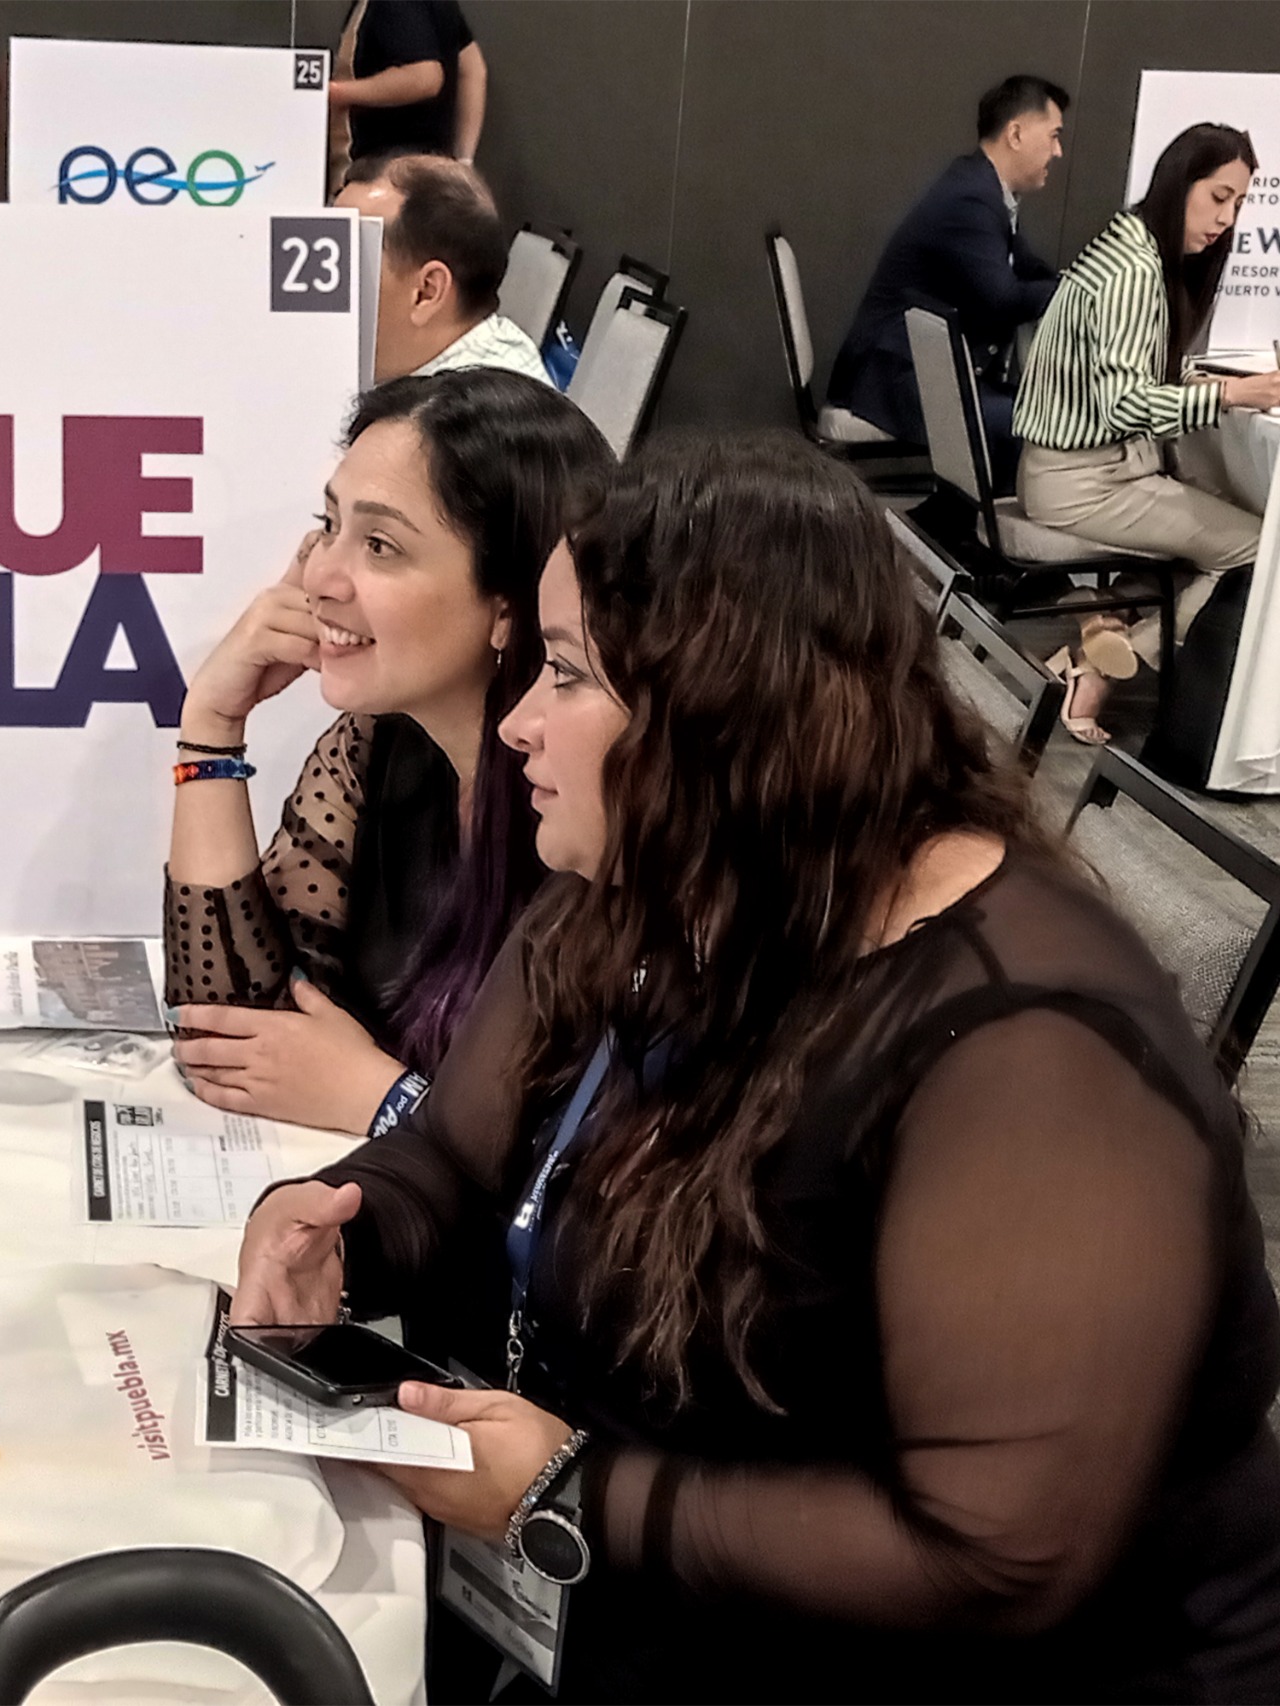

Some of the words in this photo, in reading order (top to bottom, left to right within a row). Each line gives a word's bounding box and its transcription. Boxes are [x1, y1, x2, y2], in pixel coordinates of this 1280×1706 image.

[297, 59, 321, 84] 25
[282, 237, 340, 293] 23
[106, 1329, 170, 1461] visitpuebla.mx
